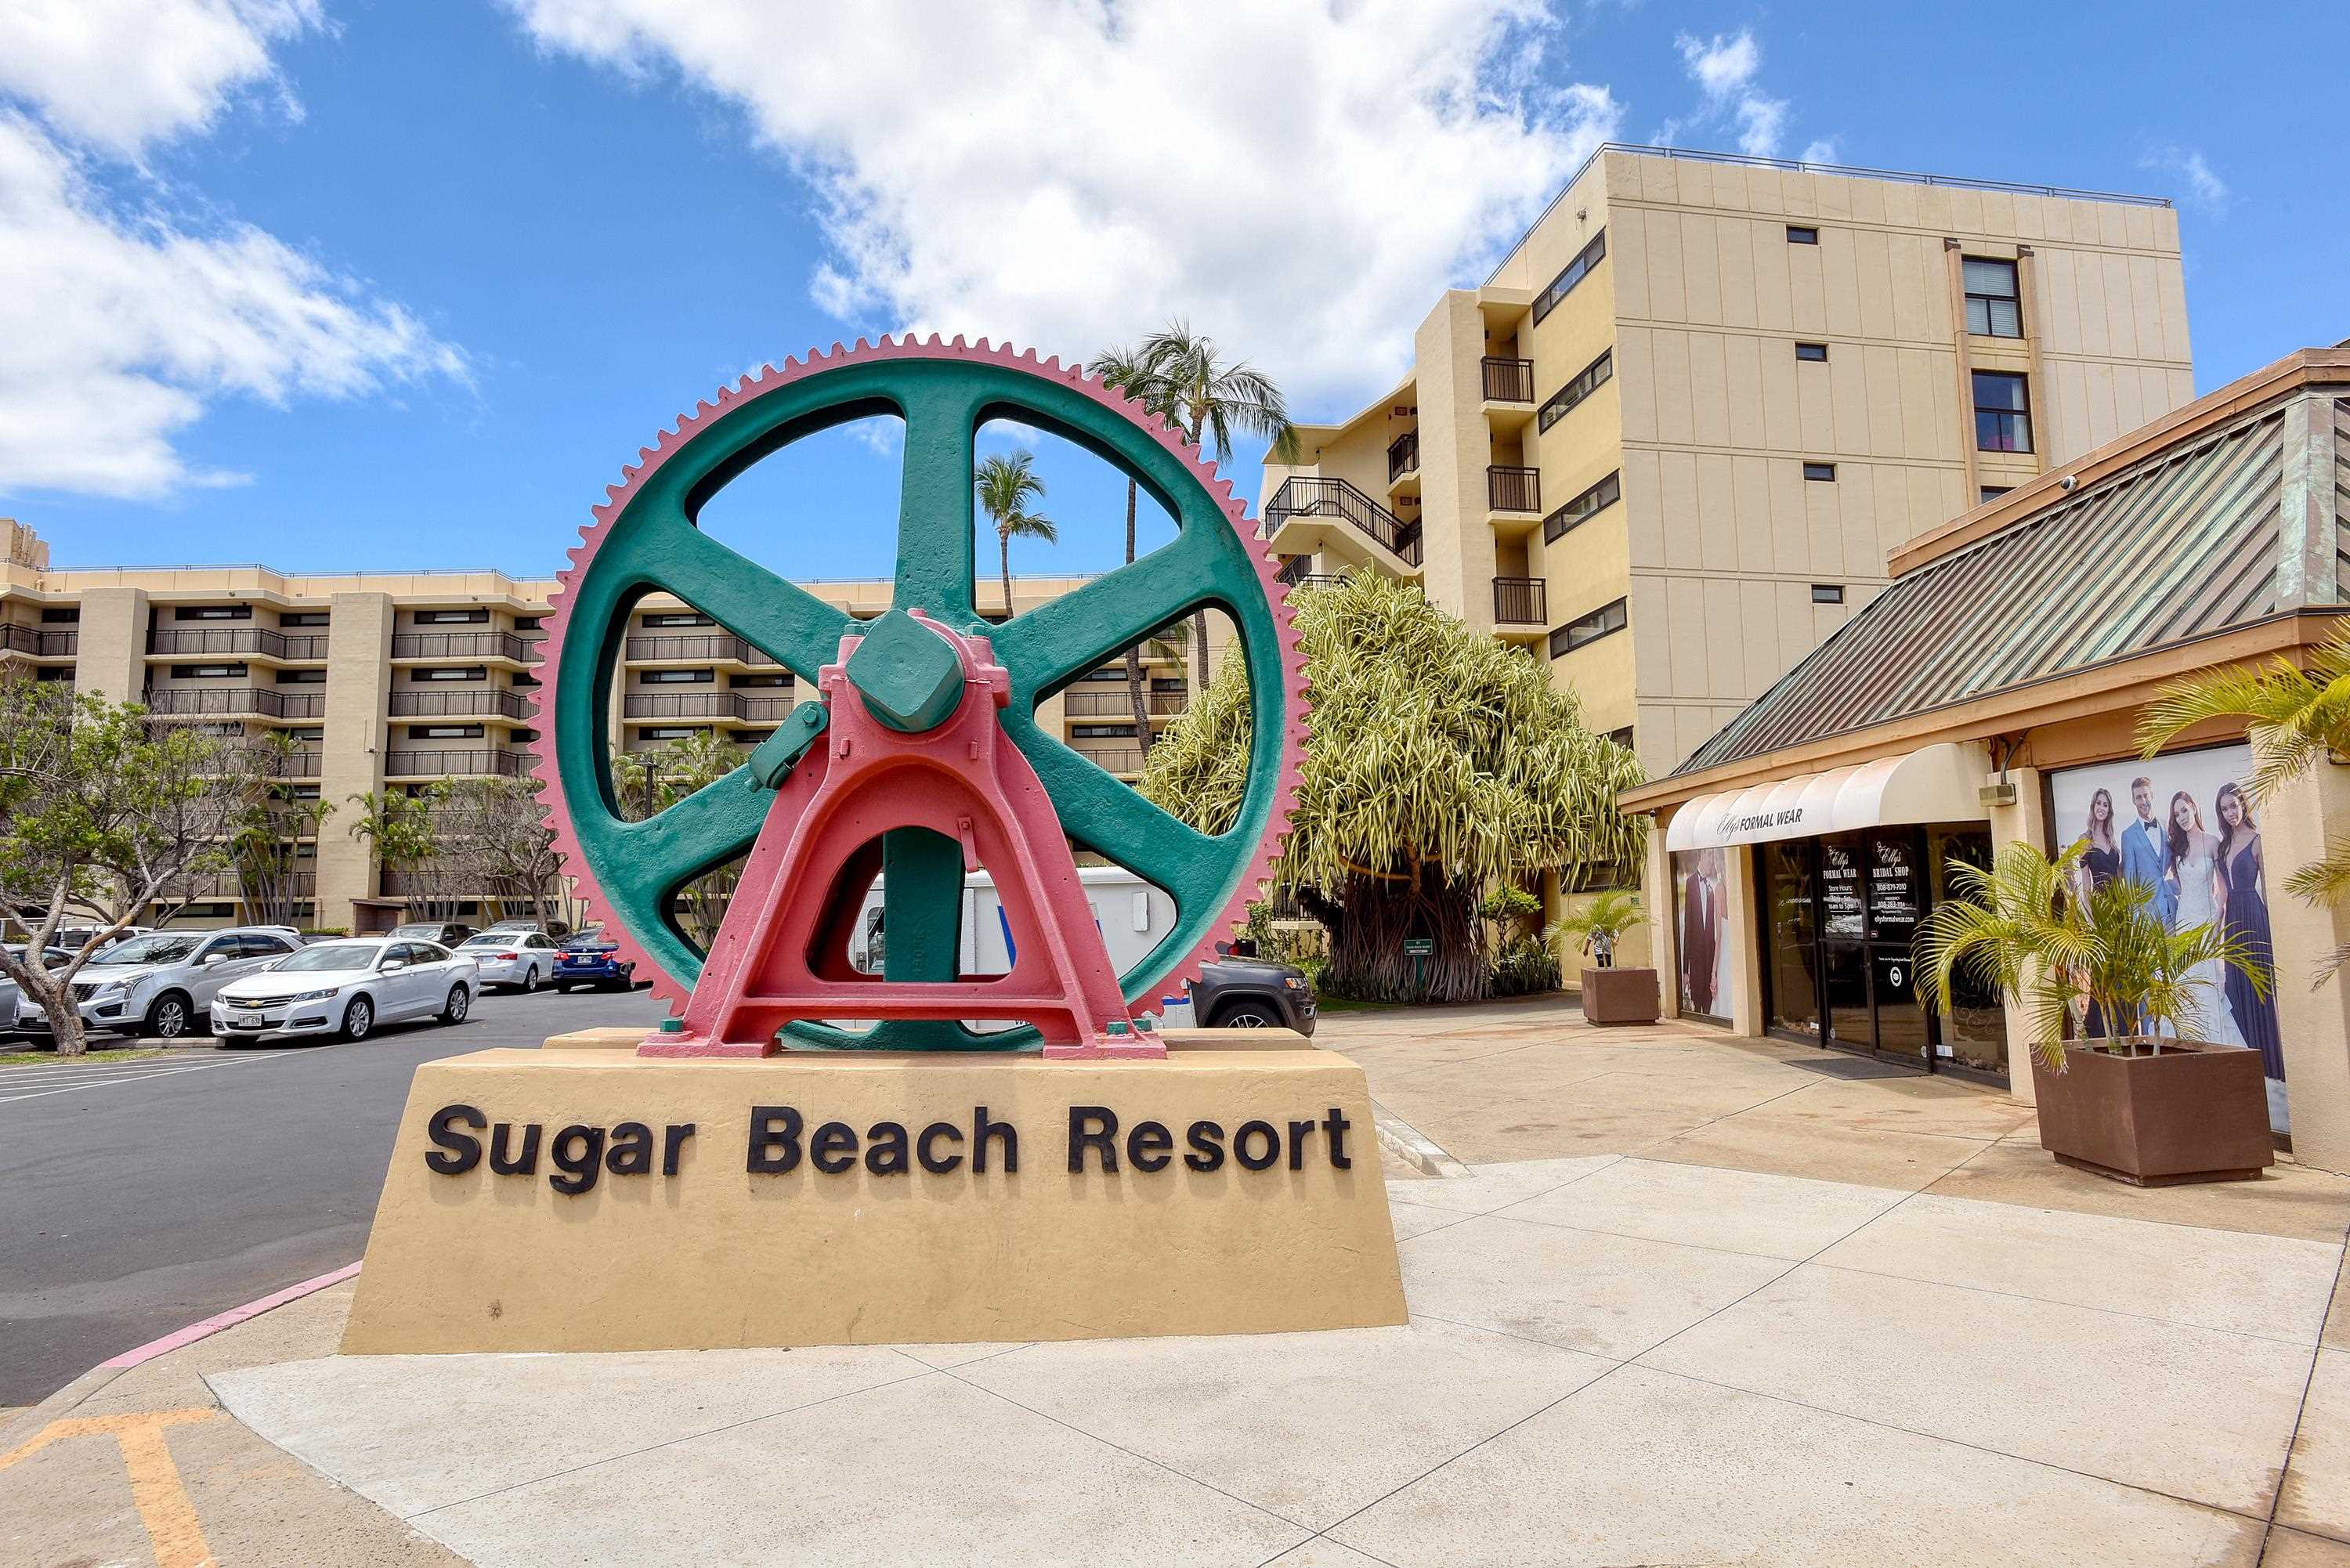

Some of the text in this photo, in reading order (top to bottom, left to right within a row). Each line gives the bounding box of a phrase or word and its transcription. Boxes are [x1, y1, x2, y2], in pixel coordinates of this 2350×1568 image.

[1740, 814, 1773, 832] FORMAL
[1777, 808, 1802, 826] WEAR
[1823, 869, 1857, 880] FORMAL WEAR
[1872, 865, 1909, 878] BRIDAL SHOP
[425, 1104, 1352, 1196] Sugar Beach Resort
